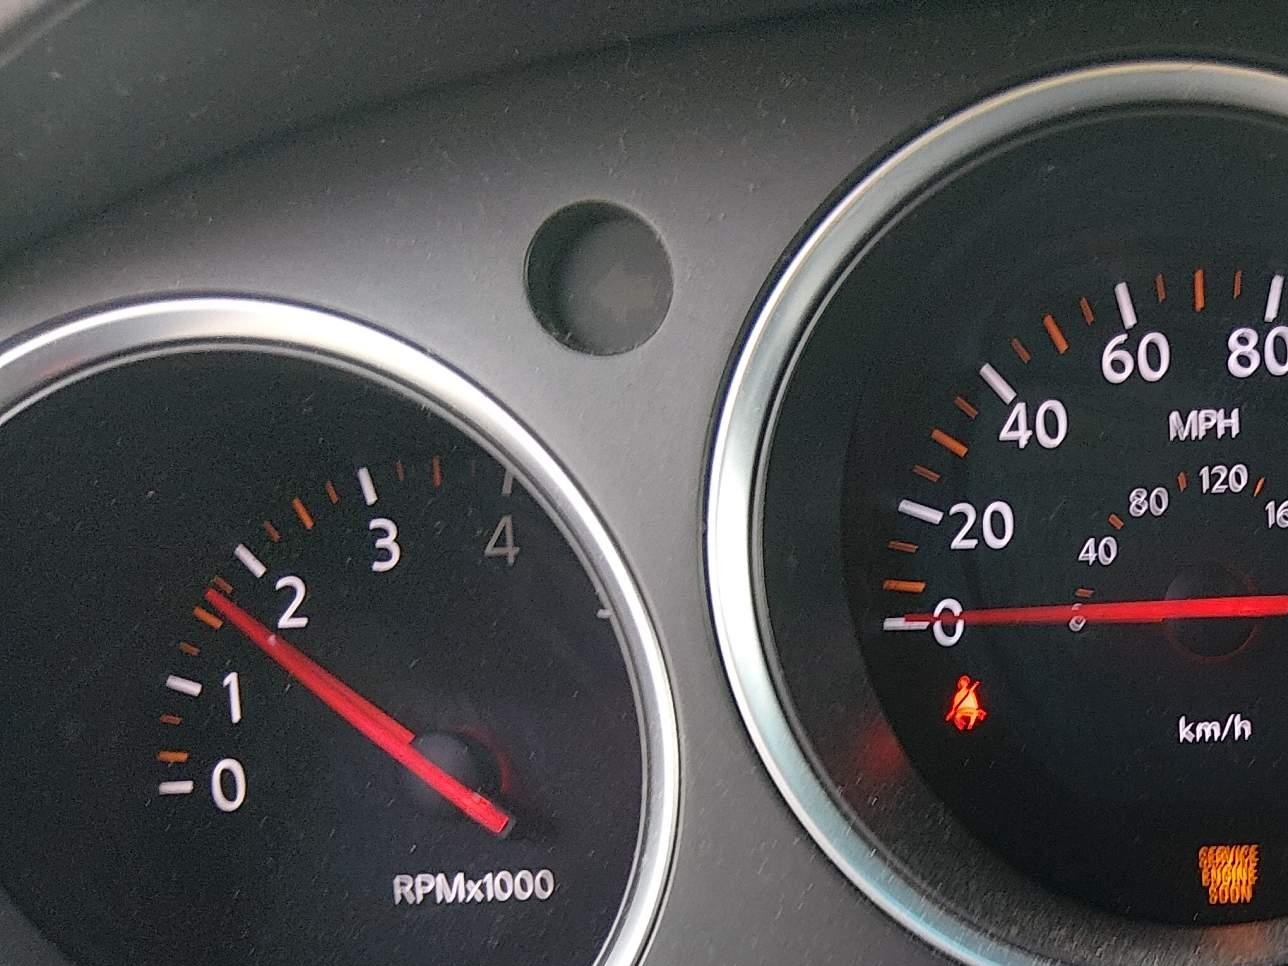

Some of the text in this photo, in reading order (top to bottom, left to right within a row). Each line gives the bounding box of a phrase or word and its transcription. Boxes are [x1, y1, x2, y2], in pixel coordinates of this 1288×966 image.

[1101, 331, 1171, 385] 60
[999, 398, 1068, 450] 40
[1168, 407, 1240, 441] MPH
[1200, 464, 1248, 494] 120
[1128, 487, 1169, 517] 80
[368, 517, 401, 573] 3
[483, 515, 520, 567] 4
[948, 501, 1015, 551] 20
[1077, 537, 1117, 565] 40
[274, 575, 309, 630] 2
[931, 597, 965, 648] 0
[222, 671, 242, 724] 1
[1178, 713, 1253, 743] km/h
[211, 758, 246, 813] 0
[1198, 844, 1260, 866] SERVICE
[1200, 865, 1259, 886] ENGINE
[392, 869, 556, 906] RPMx1000
[1206, 885, 1253, 905] SOON
